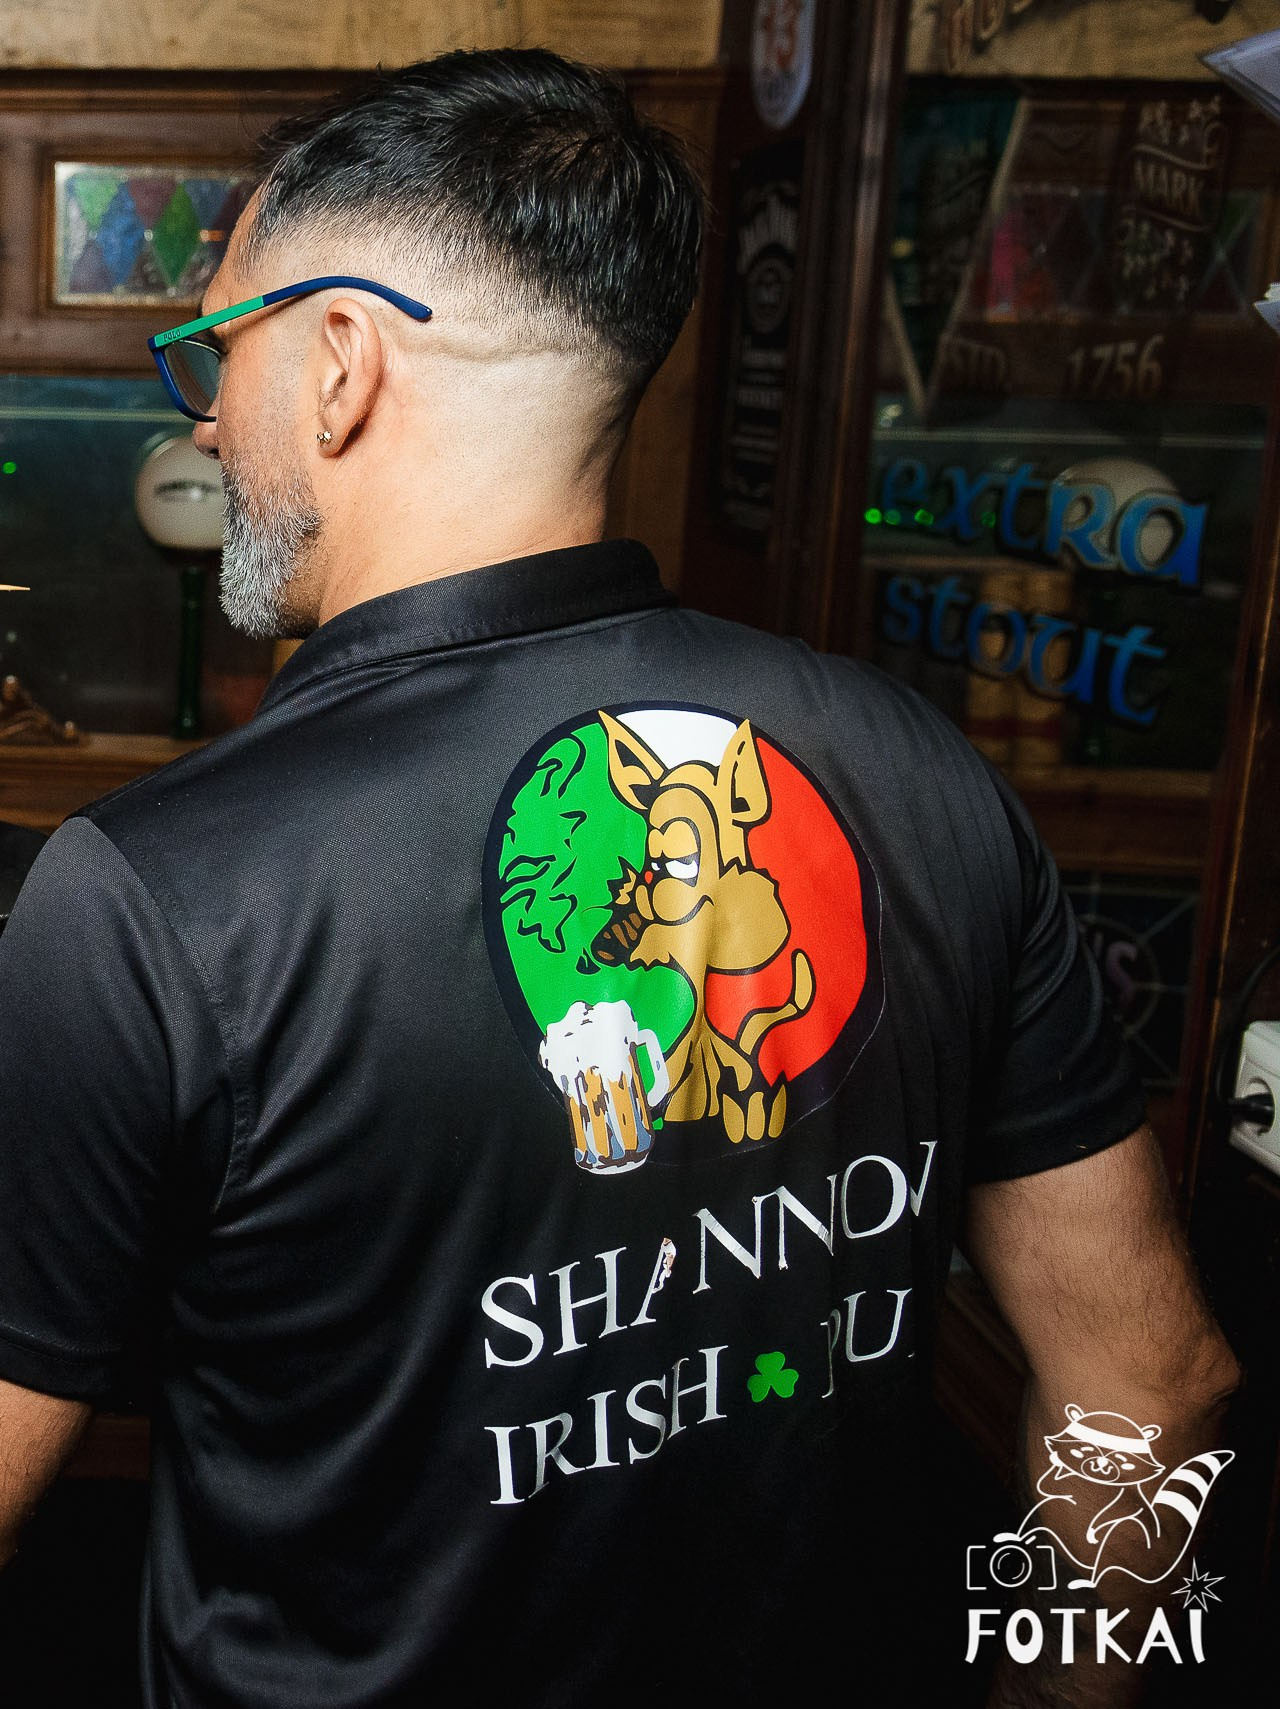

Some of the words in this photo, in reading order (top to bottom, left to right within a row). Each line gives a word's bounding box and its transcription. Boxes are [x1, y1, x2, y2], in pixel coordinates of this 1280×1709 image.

[1064, 332, 1167, 400] 1756
[880, 574, 1169, 727] stout
[483, 1345, 729, 1506] IRISH
